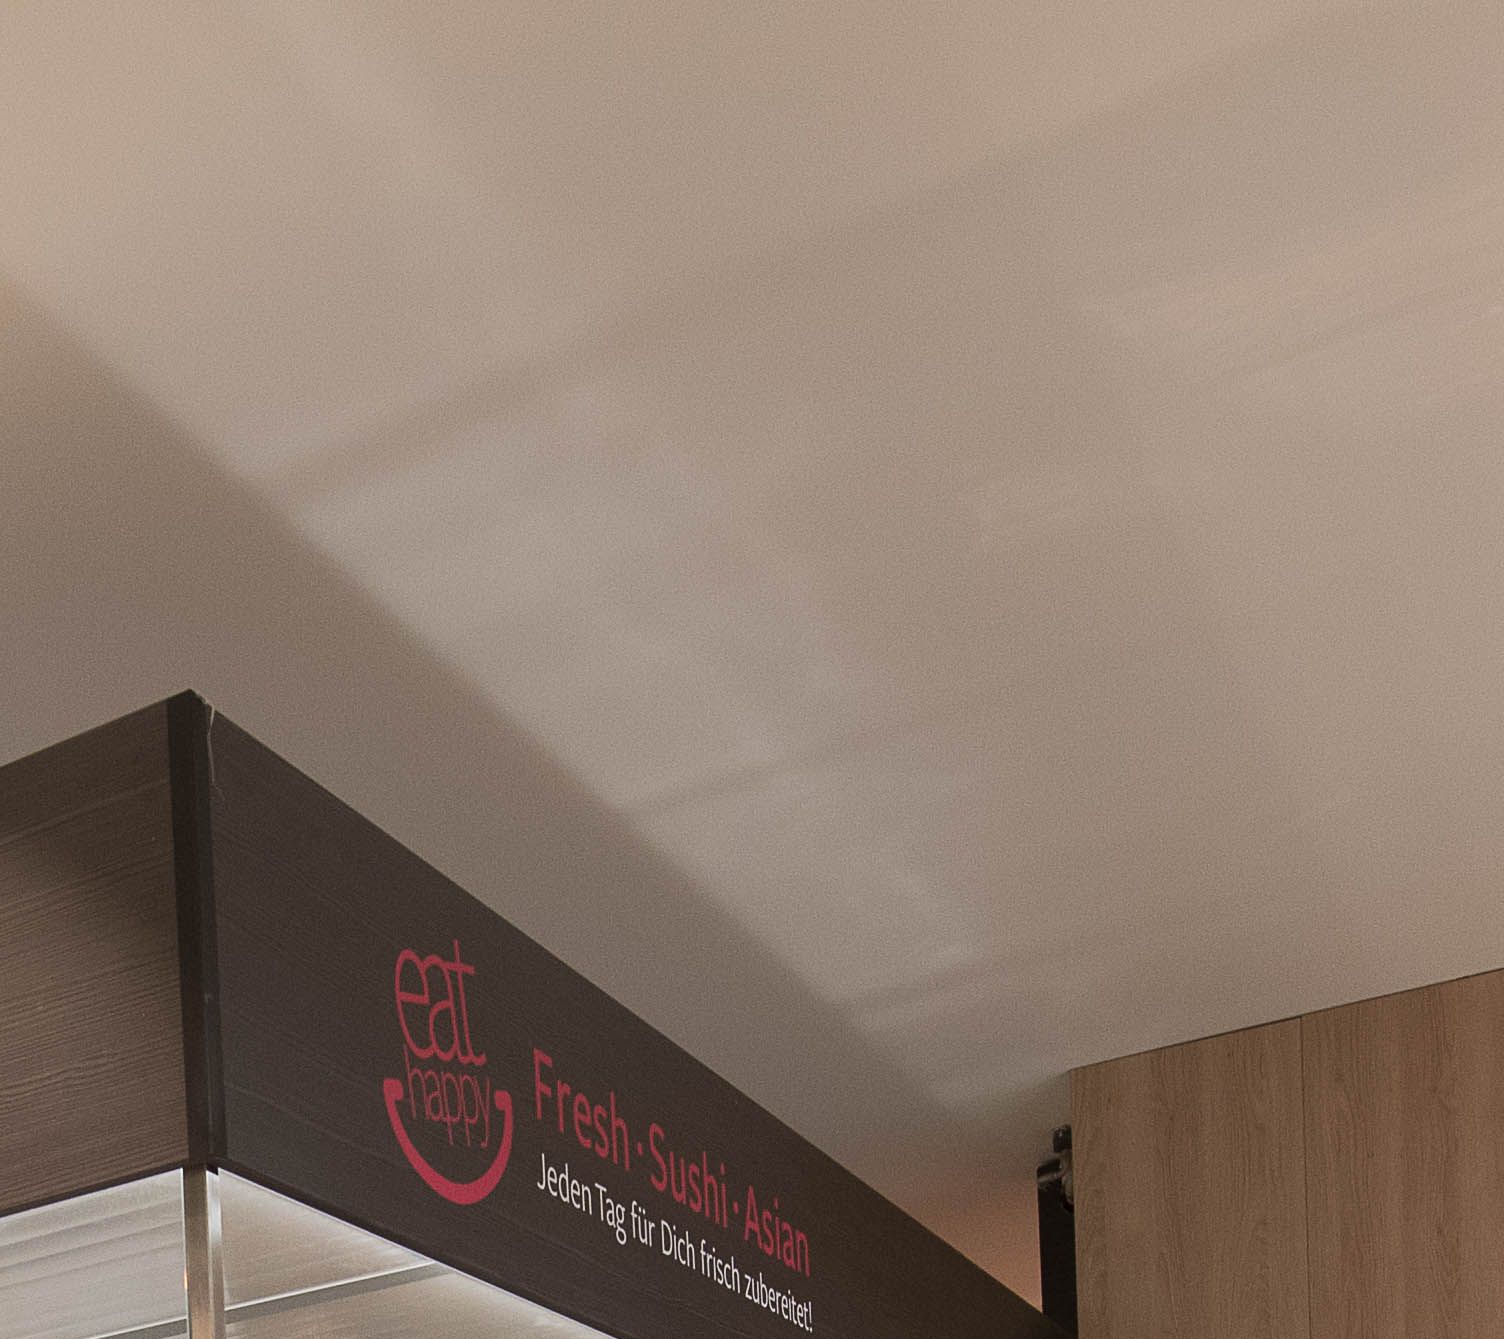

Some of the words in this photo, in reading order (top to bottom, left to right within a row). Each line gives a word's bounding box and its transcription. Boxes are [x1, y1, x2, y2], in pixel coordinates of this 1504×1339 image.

[394, 939, 486, 1066] eat
[403, 1047, 491, 1149] happy
[533, 1047, 630, 1171] Fresh
[649, 1122, 728, 1229] Sushi
[744, 1185, 811, 1277] Asian
[536, 1152, 592, 1216] Jeden
[595, 1182, 627, 1245] Tag
[630, 1201, 656, 1248] für
[660, 1219, 696, 1271] Dich
[700, 1238, 741, 1294] frisch
[744, 1273, 814, 1334] zubereitet!
